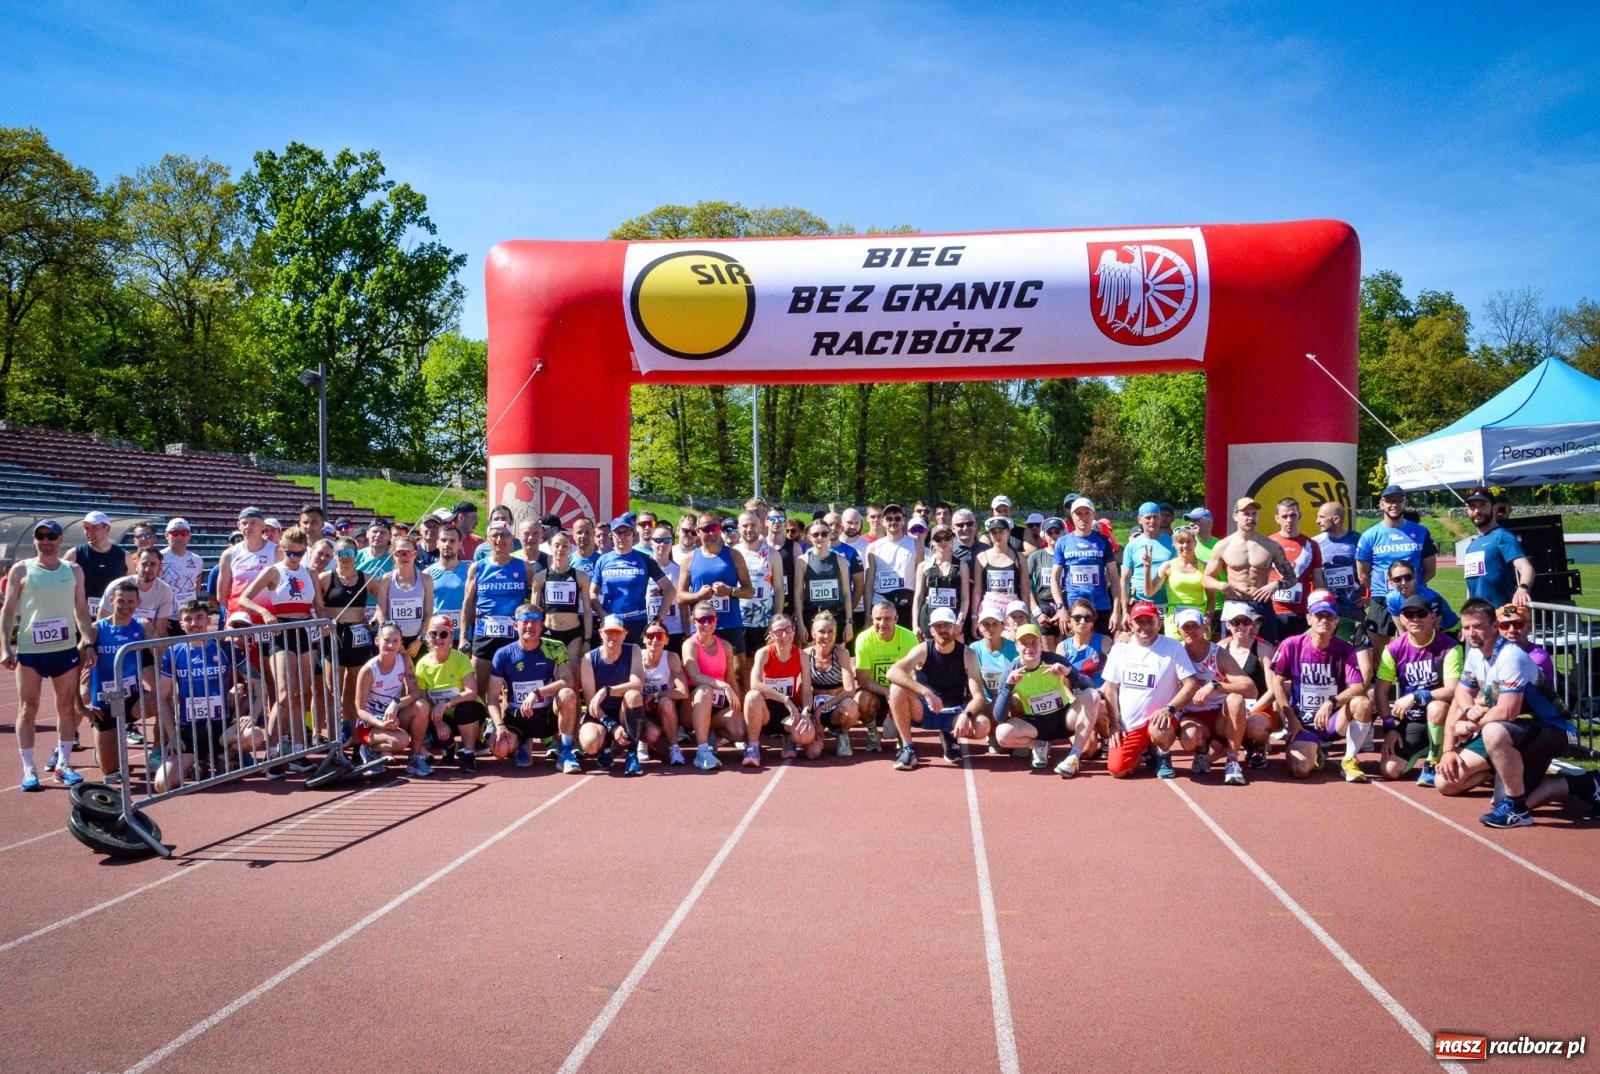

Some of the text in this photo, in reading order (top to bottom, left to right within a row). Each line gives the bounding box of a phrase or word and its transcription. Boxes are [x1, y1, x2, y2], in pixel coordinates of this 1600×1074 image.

[862, 246, 966, 268] BIEG
[690, 263, 750, 286] SIR
[787, 279, 1044, 314] BEZ GRANIC
[810, 321, 1023, 357] RACIBÓRZ
[1303, 481, 1351, 508] SIR
[1373, 542, 1424, 555] RUNNERS
[1064, 549, 1104, 560] RUNNERS
[601, 567, 645, 577] RUNNERS
[883, 576, 898, 587] 227
[990, 576, 1006, 588] 233
[1076, 573, 1089, 583] 115
[1328, 575, 1346, 586] 239
[477, 581, 525, 591] RUNNERS
[553, 591, 563, 600] 111
[815, 588, 830, 598] 210
[932, 595, 949, 605] 228
[396, 607, 412, 617] 182
[489, 623, 505, 634] 129
[39, 629, 59, 640] 102
[1301, 662, 1331, 685] RUN
[1405, 659, 1432, 682] RUN
[1128, 672, 1145, 684] 132
[1308, 695, 1325, 705] 231
[1035, 701, 1053, 712] 197
